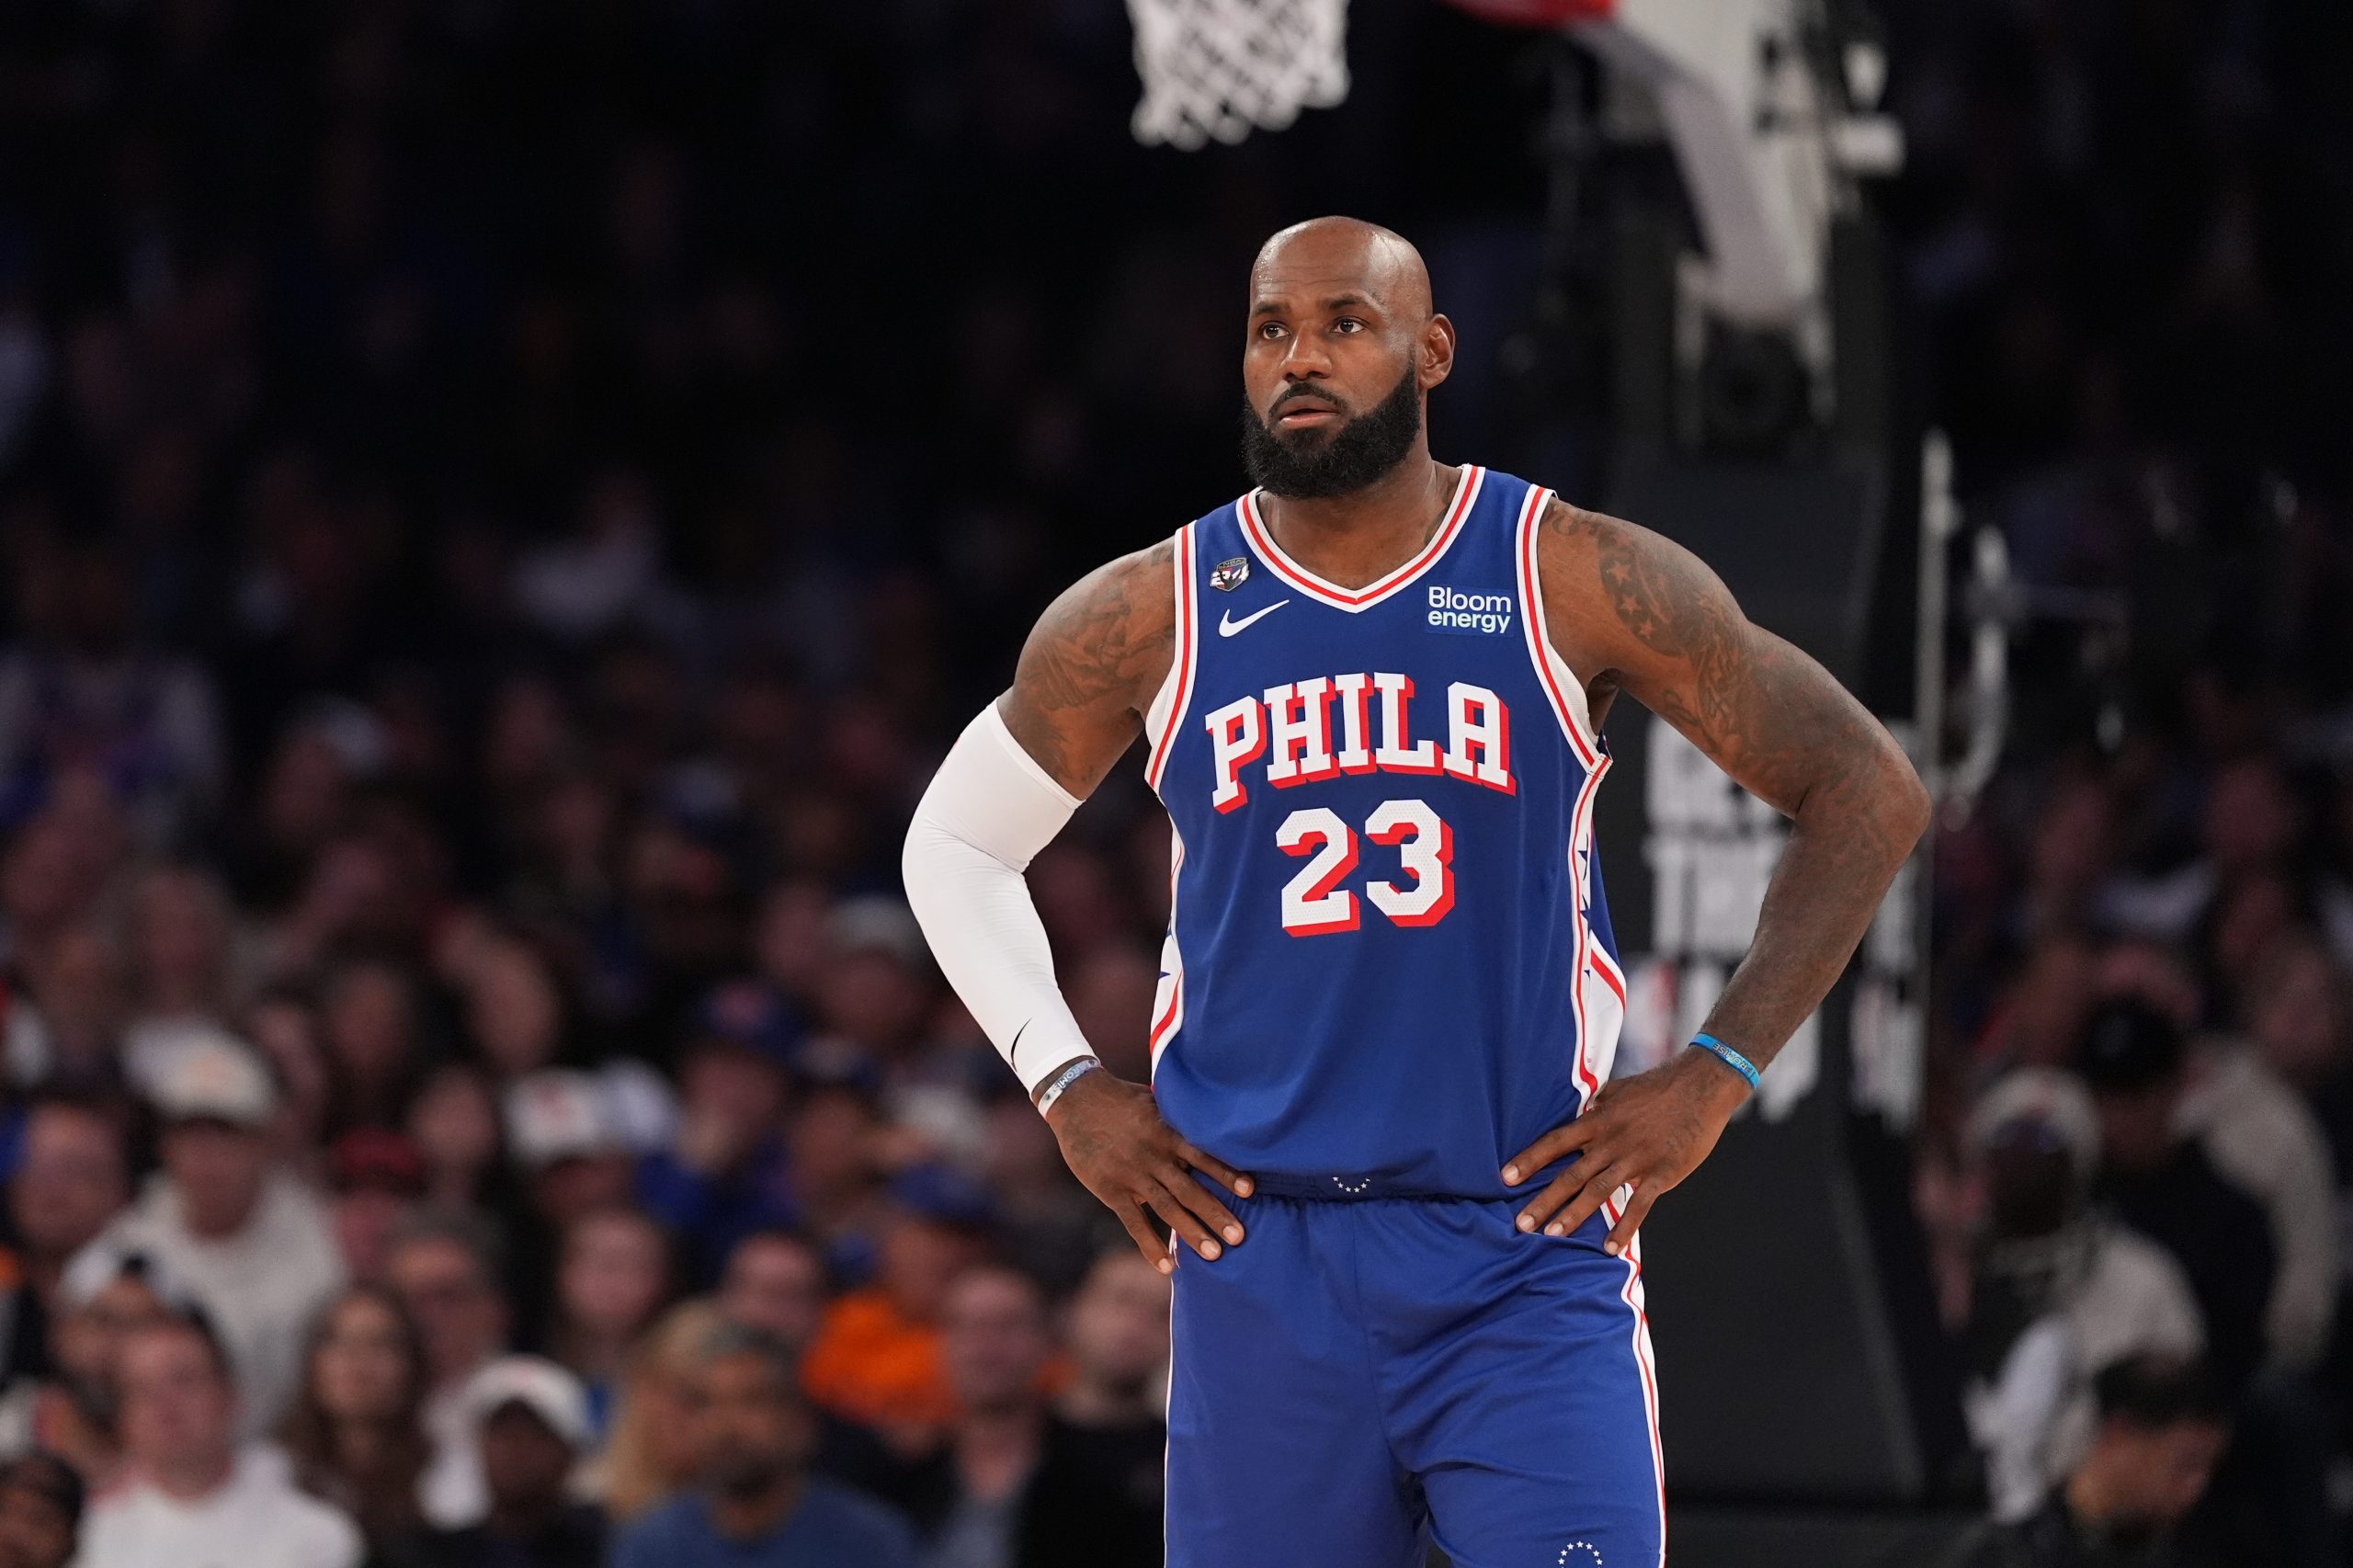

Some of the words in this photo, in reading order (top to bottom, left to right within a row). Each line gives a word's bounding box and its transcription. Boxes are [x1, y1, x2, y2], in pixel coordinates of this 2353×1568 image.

[1427, 609, 1512, 634] energy
[1428, 585, 1512, 613] Bloom
[1205, 672, 1517, 815] PHILA
[1275, 799, 1454, 937] 23
